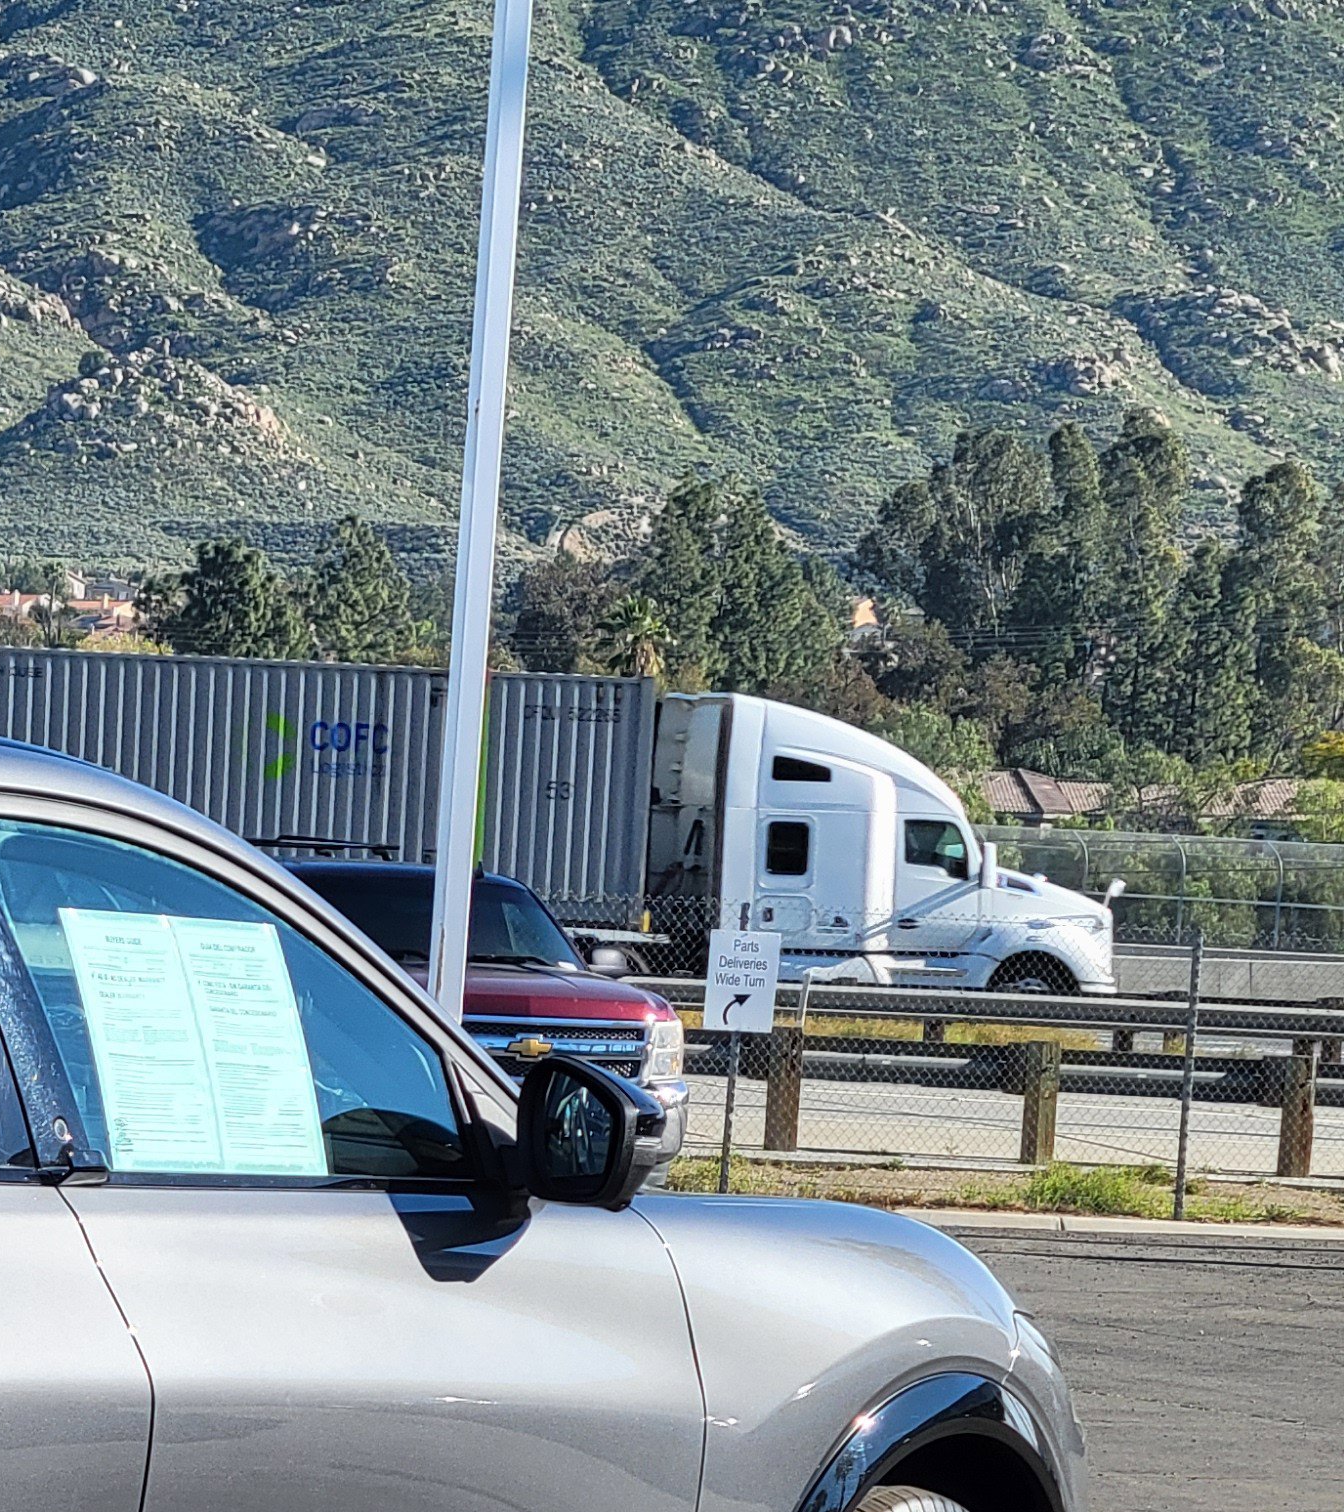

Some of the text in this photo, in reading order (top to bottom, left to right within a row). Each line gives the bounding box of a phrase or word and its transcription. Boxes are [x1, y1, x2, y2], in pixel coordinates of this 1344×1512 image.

[310, 721, 389, 754] COFC
[733, 939, 759, 953] Parts
[719, 955, 768, 971] Deliveries
[715, 972, 765, 988] Wide Turn
